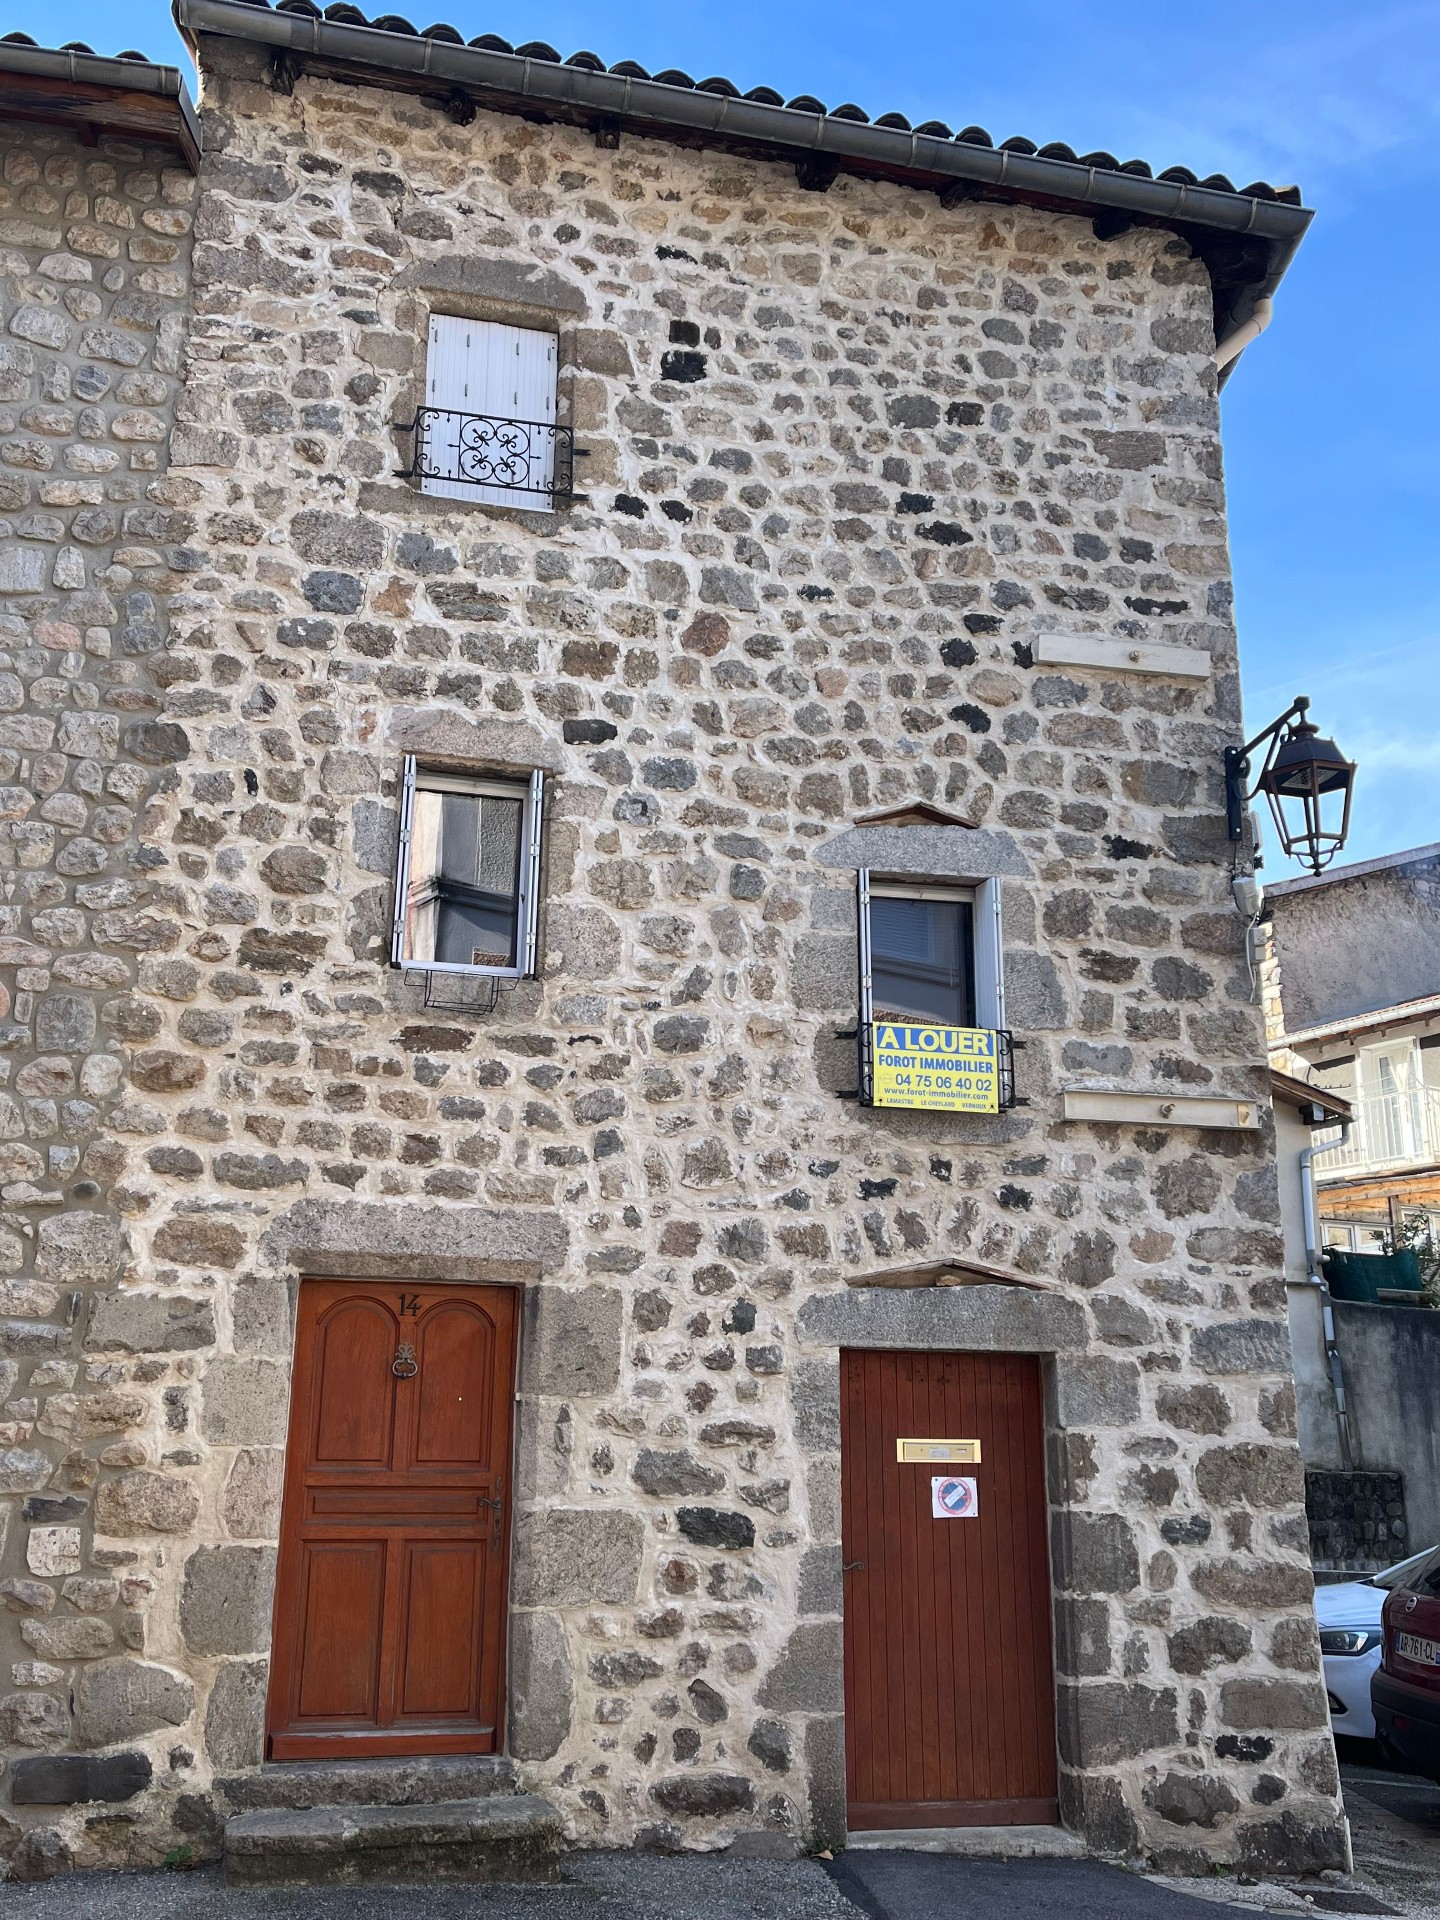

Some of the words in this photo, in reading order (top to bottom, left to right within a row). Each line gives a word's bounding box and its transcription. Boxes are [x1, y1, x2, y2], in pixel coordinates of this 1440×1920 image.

[879, 1027, 900, 1049] A
[904, 1029, 990, 1055] LOUER
[879, 1054, 917, 1068] FOROT
[920, 1057, 993, 1074] IMMOBILIER
[895, 1073, 911, 1086] 04
[916, 1075, 932, 1087] 75
[936, 1076, 952, 1089] 06
[956, 1077, 972, 1090] 40
[976, 1079, 992, 1092] 02
[884, 1088, 989, 1100] www.forot-immobilier.com
[398, 1293, 422, 1317] 14
[1401, 1635, 1435, 1660] AR-761-CL
